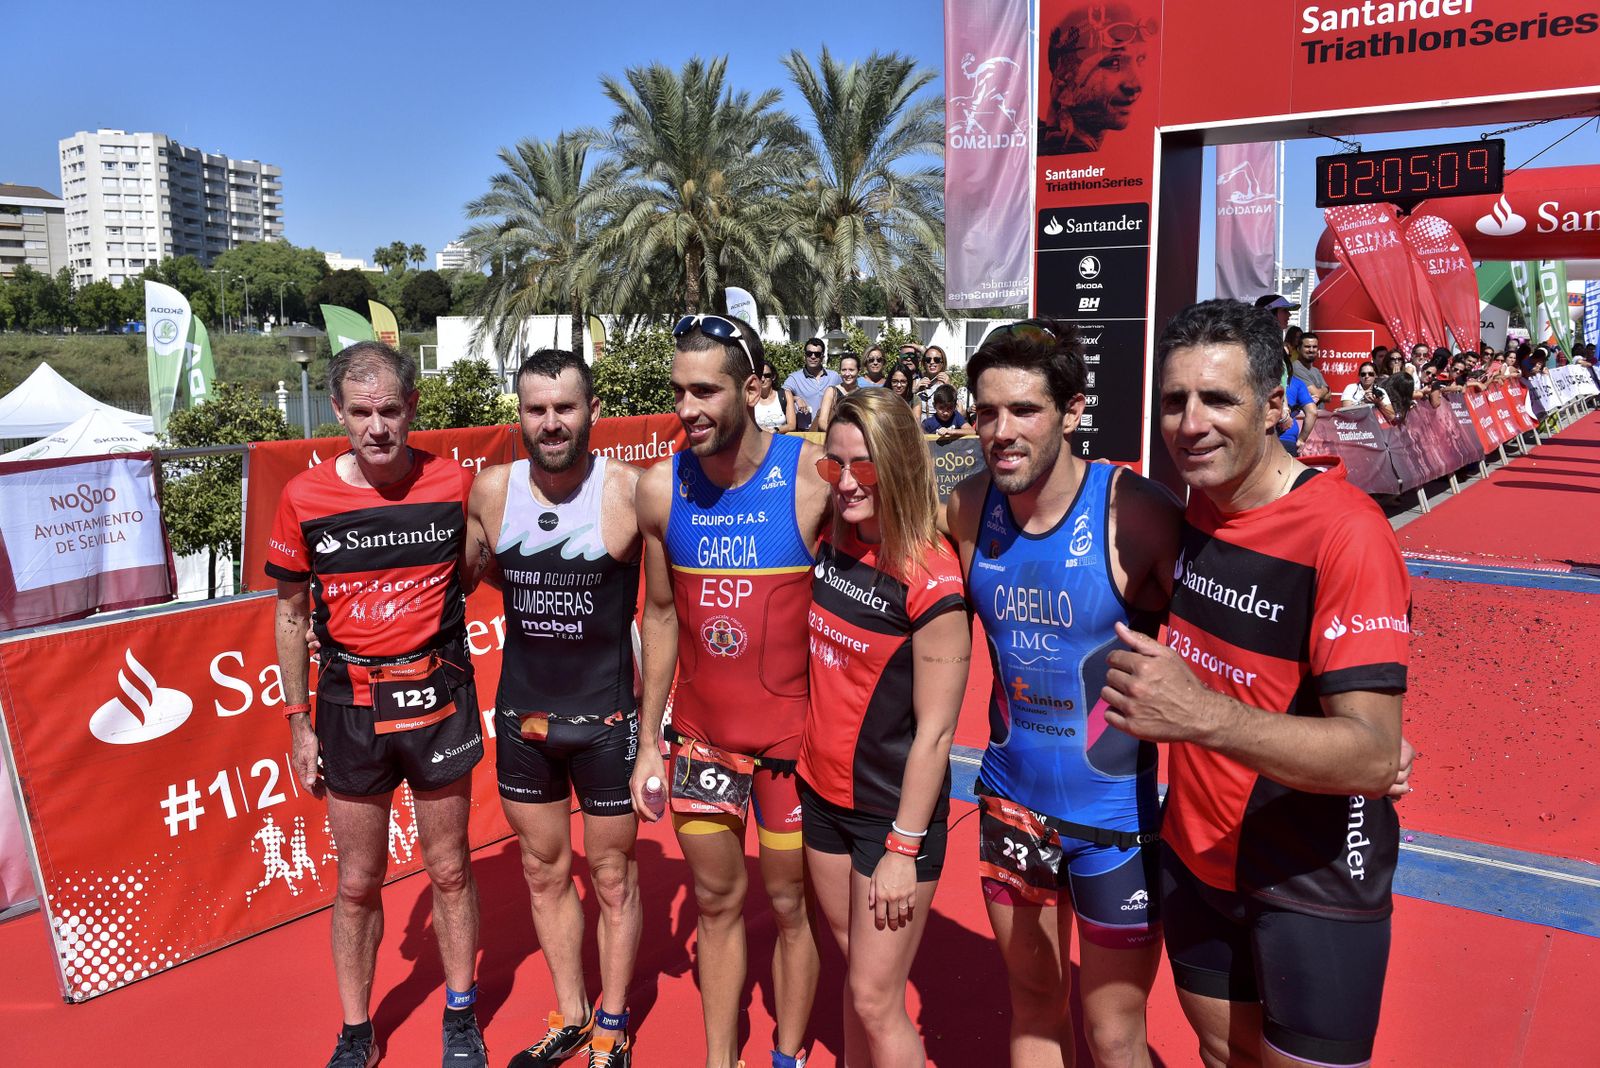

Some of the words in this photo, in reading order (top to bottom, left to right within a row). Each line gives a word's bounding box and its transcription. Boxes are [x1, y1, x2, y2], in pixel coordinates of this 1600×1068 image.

[1301, 12, 1599, 64] TriathlonSeries
[1045, 165, 1105, 181] Santander
[1046, 176, 1143, 193] TriathlonSeries
[1328, 148, 1488, 200] 02:05:09
[1066, 214, 1142, 233] Santander
[1079, 297, 1100, 309] BH
[34, 509, 144, 541] AYUNTAMIENTO
[691, 514, 733, 526] EQUIPO
[737, 511, 769, 525] F.A.S.
[346, 522, 455, 551] Santander
[697, 535, 758, 567] GARCIA
[513, 587, 594, 616] LUMBRERAS
[700, 578, 753, 608] ESP
[824, 566, 891, 614] Santander
[1182, 560, 1284, 623] Santander
[994, 584, 1073, 628] CABELLO
[521, 619, 583, 633] mobel
[556, 632, 584, 640] TEAM
[1010, 629, 1060, 652] IMC
[392, 686, 437, 709] 123
[700, 767, 731, 796] 67
[1003, 836, 1029, 872] 23
